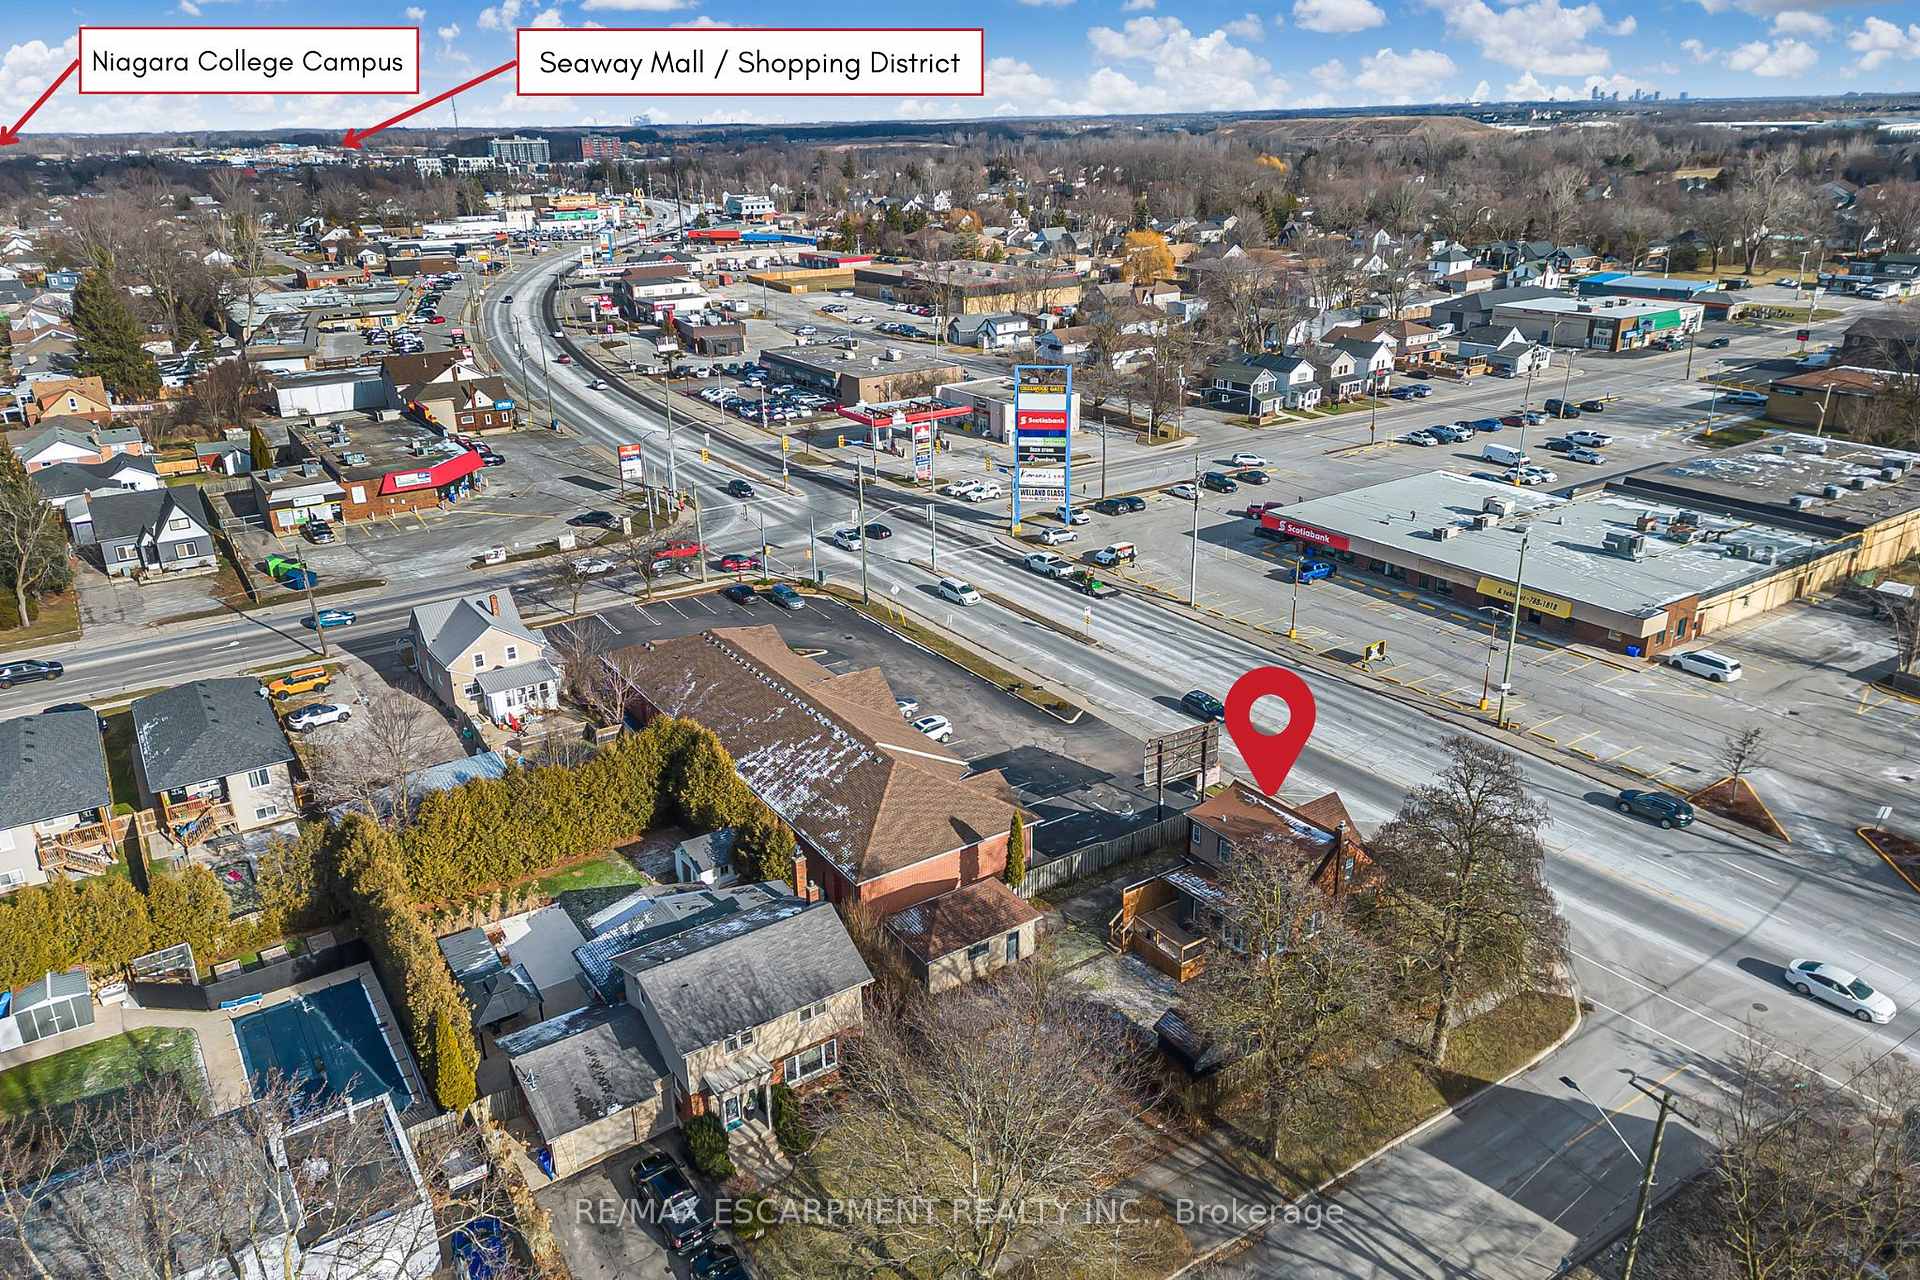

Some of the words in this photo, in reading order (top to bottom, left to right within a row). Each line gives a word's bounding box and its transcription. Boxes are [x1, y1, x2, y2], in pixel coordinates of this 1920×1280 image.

[1028, 416, 1065, 424] Scotiabank
[1020, 489, 1046, 497] WELLAND
[1046, 489, 1064, 497] GLASS
[1287, 524, 1330, 543] Scotiabank
